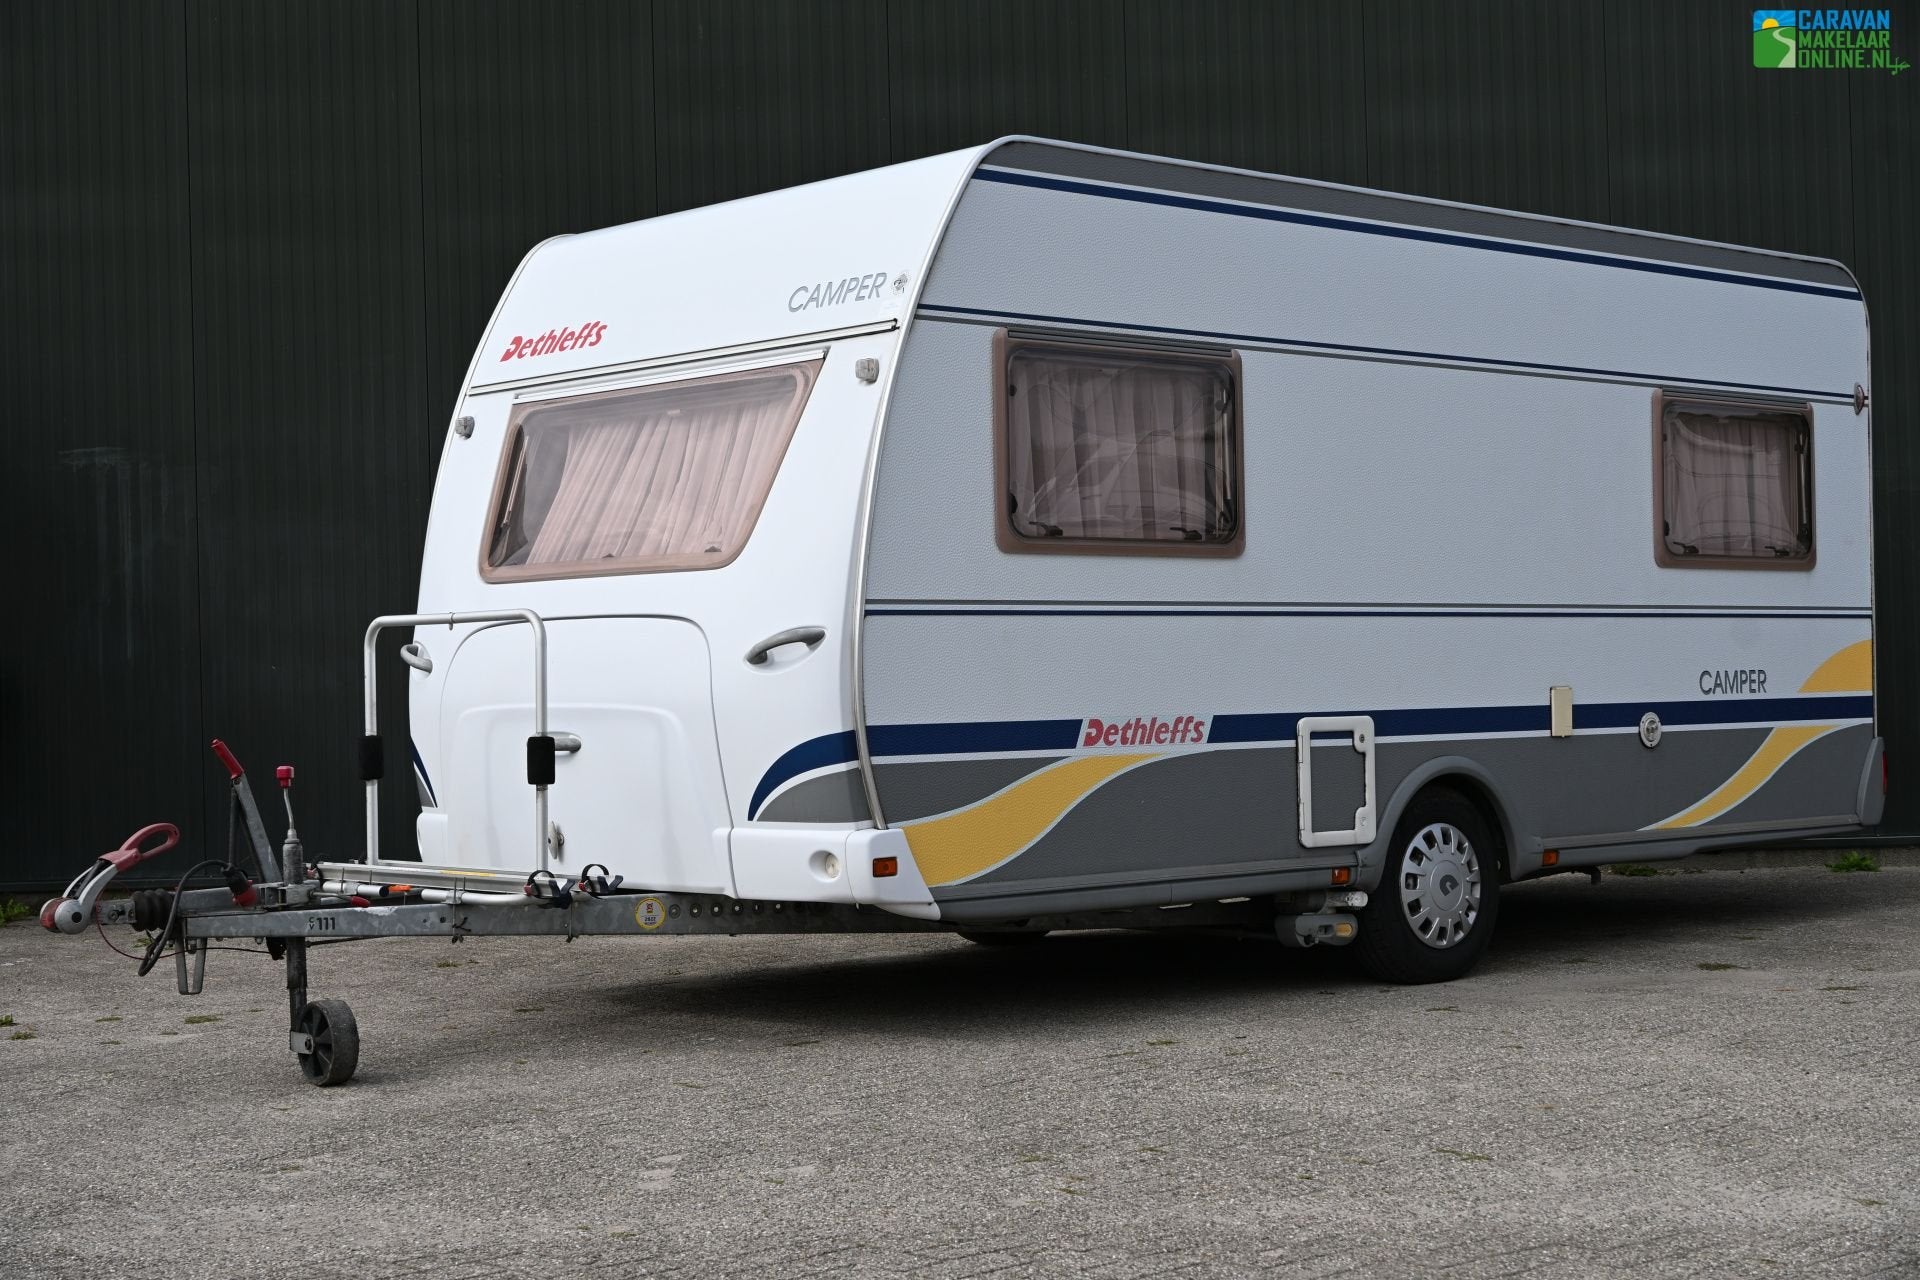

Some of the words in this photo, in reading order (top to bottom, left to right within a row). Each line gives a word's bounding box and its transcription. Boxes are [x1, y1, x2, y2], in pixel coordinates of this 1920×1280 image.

[788, 272, 888, 313] CAMPER
[501, 321, 607, 362] Dethleffs
[1699, 669, 1767, 696] CAMPER
[1083, 715, 1205, 747] Dethleffs
